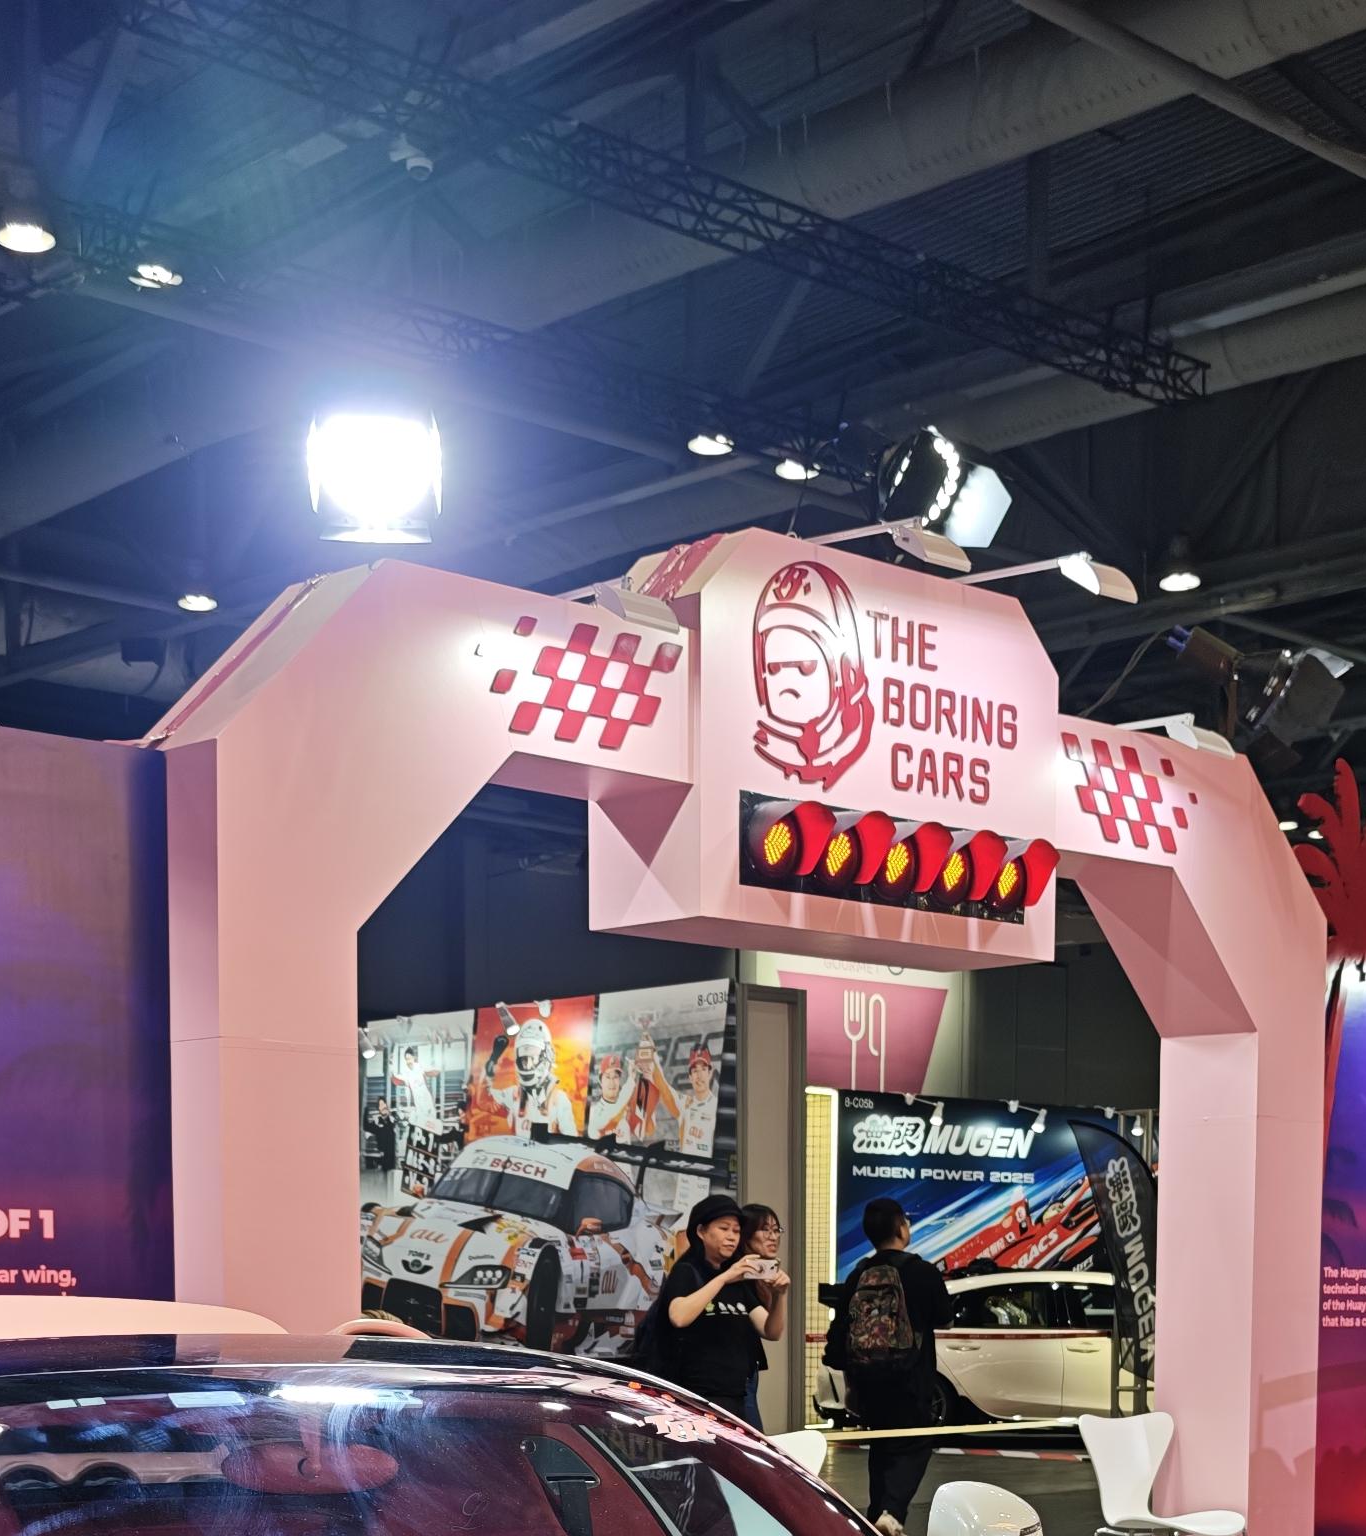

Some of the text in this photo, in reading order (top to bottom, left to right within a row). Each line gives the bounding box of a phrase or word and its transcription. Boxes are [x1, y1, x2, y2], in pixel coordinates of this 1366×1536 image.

[866, 609, 939, 672] THE
[882, 676, 1019, 751] BORING
[890, 743, 991, 805] CARS
[923, 1125, 1036, 1160] MUGEN
[490, 1157, 548, 1179] BOSCH
[852, 1165, 1036, 1185] MUGEN POWER 2025
[38, 1209, 54, 1239] 1
[21, 1264, 77, 1288] wing,
